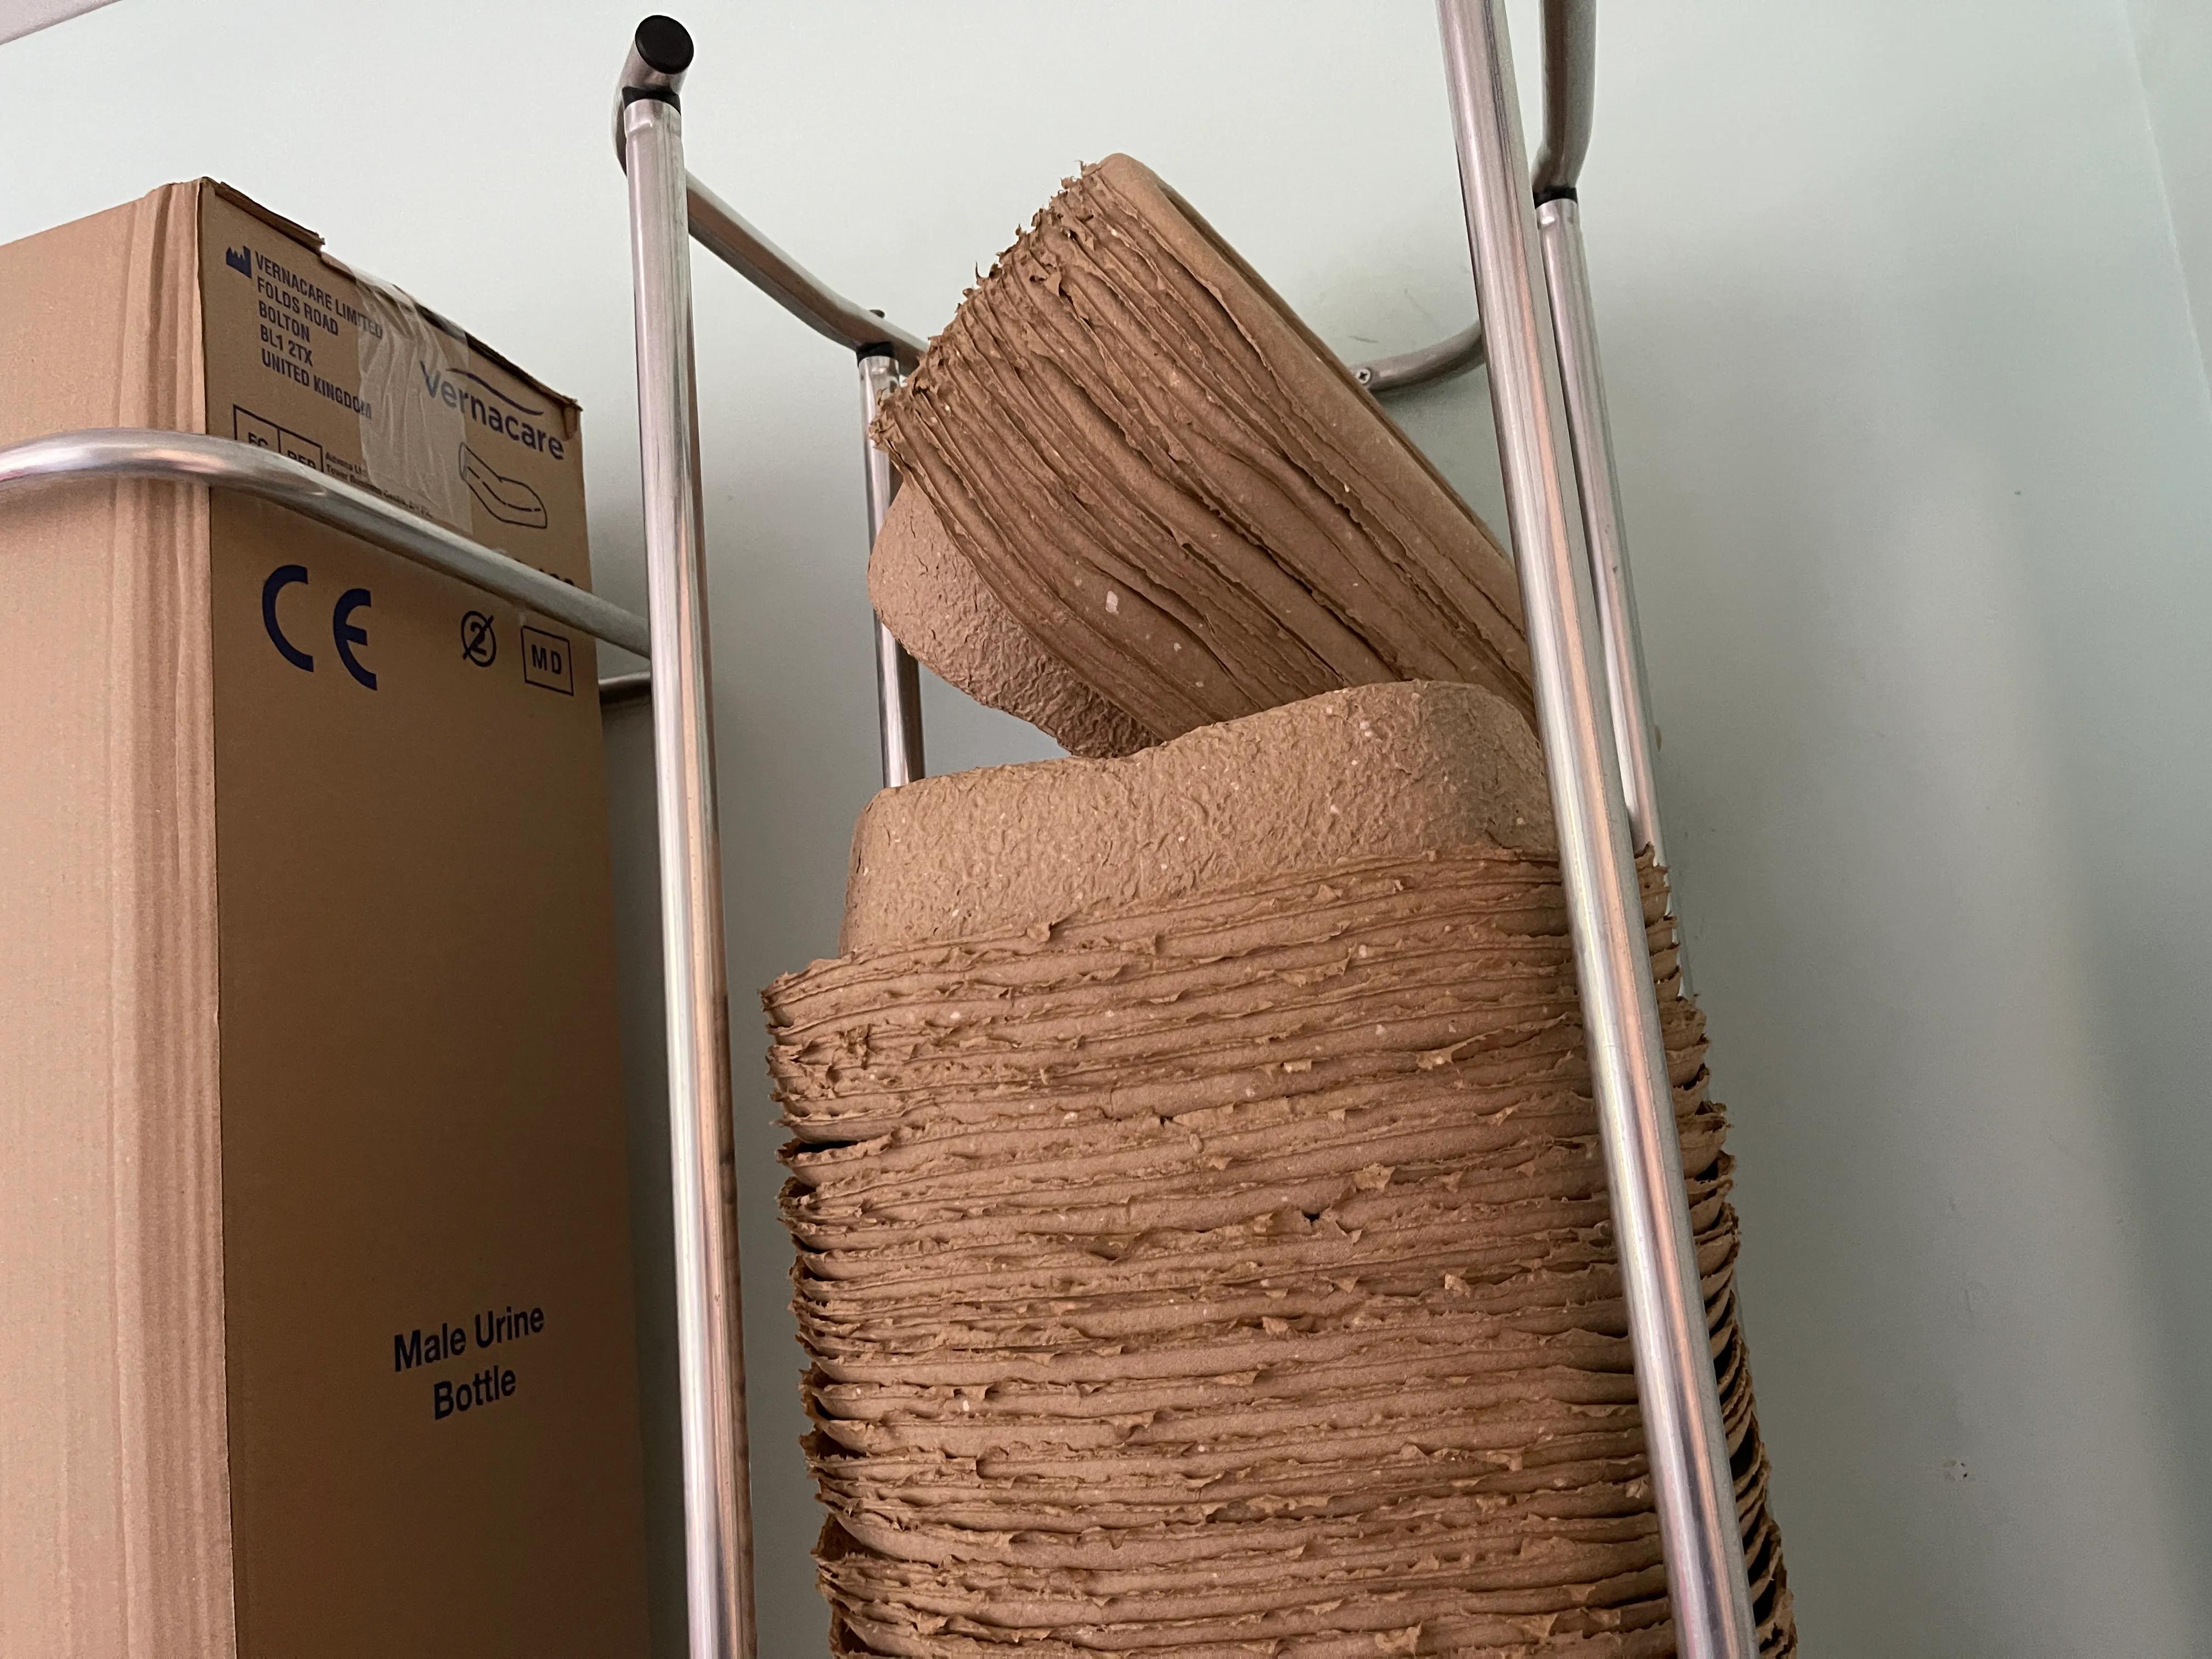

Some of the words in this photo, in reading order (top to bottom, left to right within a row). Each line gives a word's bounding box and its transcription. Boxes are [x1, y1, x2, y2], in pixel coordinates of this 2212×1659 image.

[255, 251, 332, 311] VERNACARE
[335, 298, 383, 339] LIMITED
[257, 276, 300, 314] FOLDS
[303, 302, 338, 336] ROAD
[259, 300, 310, 343] BOLTON
[260, 324, 283, 351] BL1
[288, 340, 313, 367] 2TX
[262, 348, 309, 387] UNITED
[313, 374, 371, 420] KINGDOM
[419, 359, 565, 460] Vernacare
[262, 565, 377, 691] CE
[531, 644, 561, 675] MD
[394, 1323, 466, 1372] Male
[475, 1306, 544, 1348] Urine
[433, 1365, 516, 1420] Bottle
